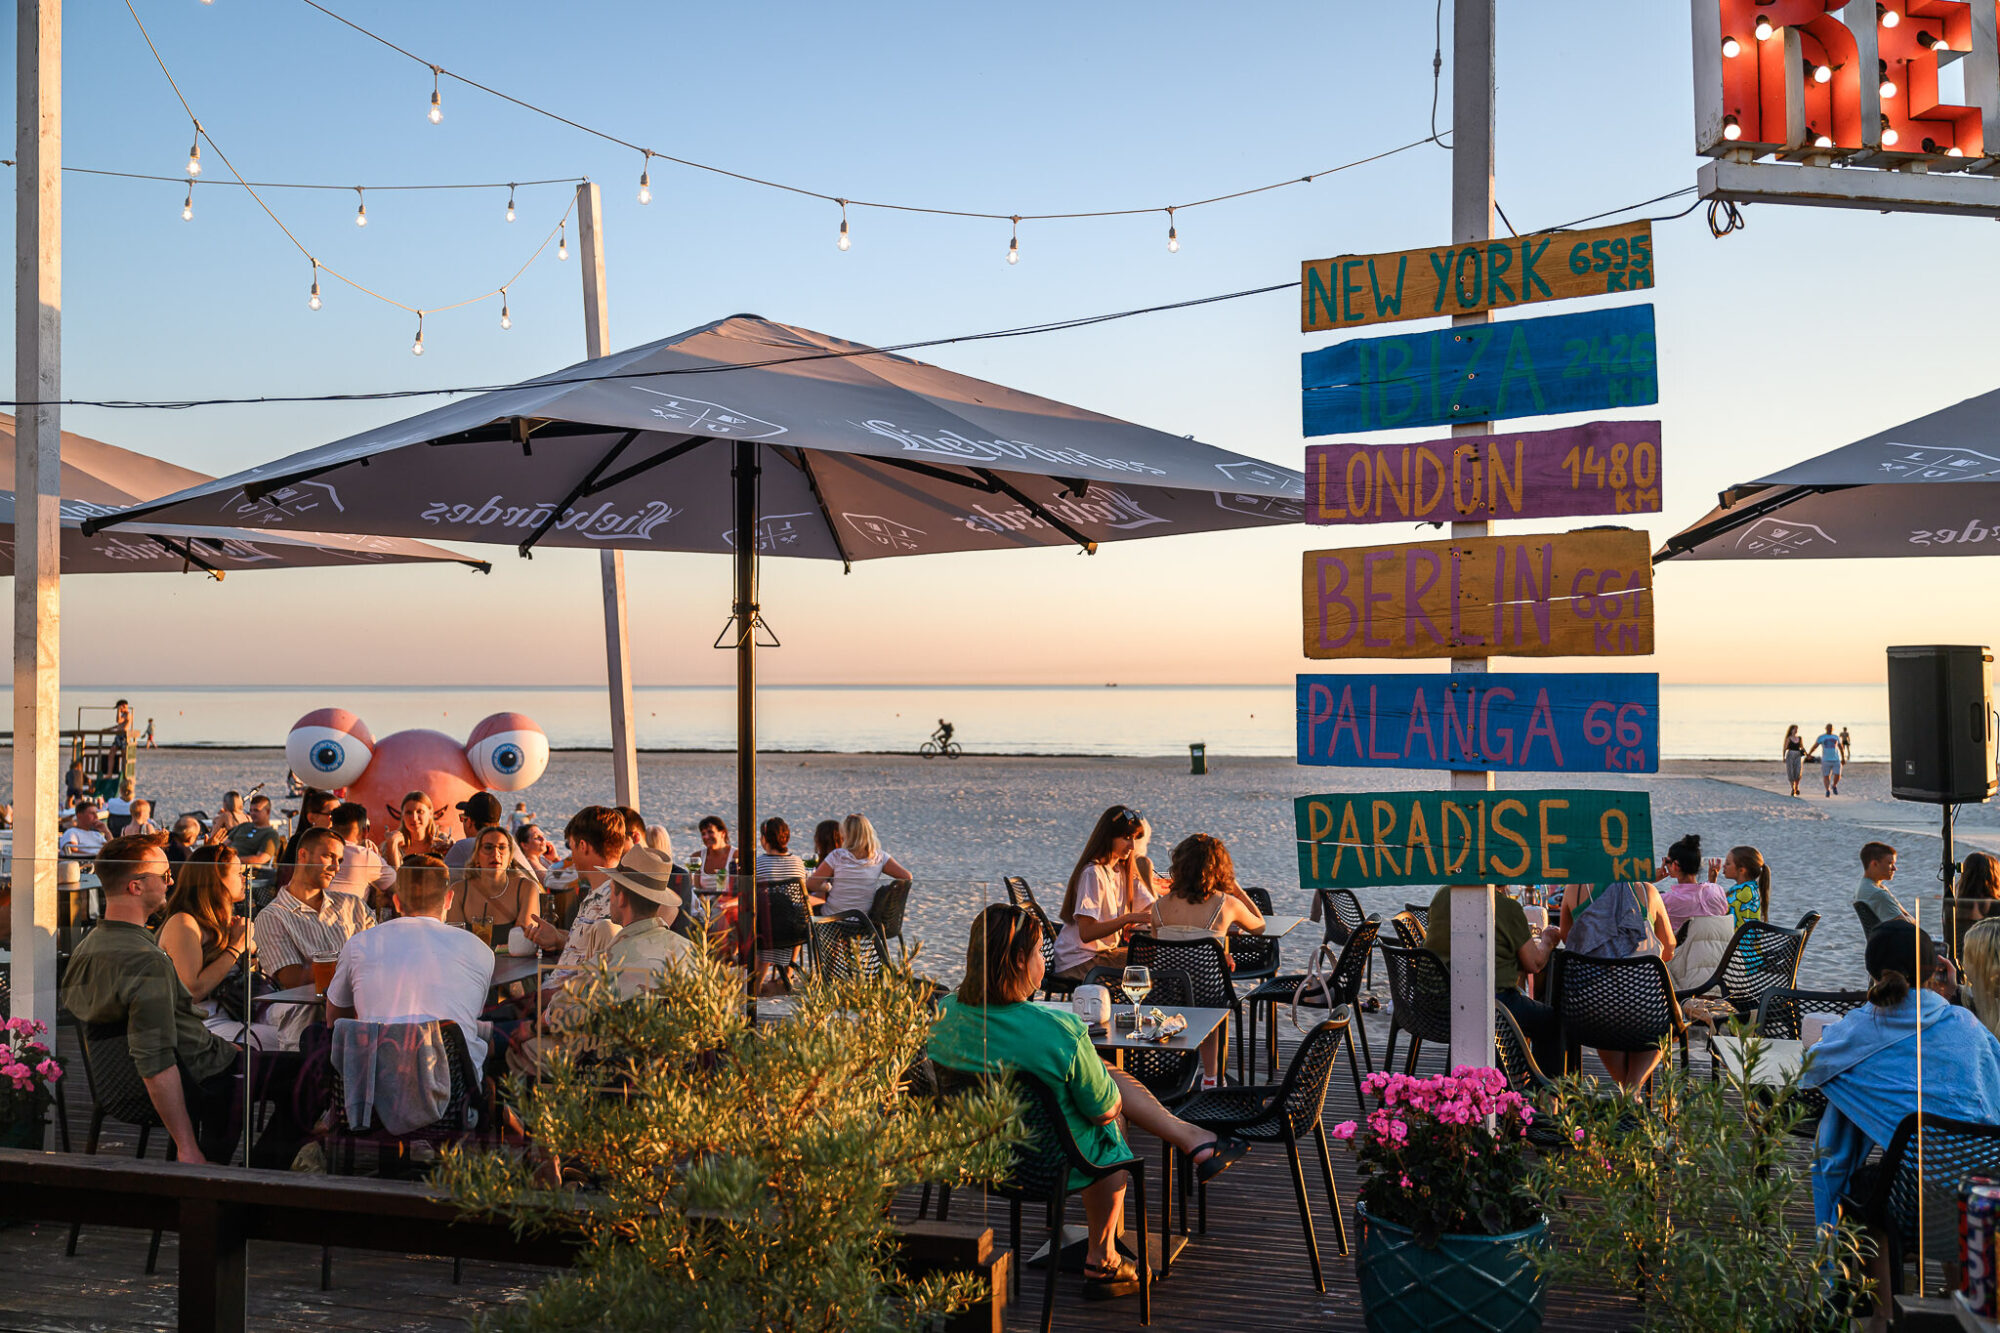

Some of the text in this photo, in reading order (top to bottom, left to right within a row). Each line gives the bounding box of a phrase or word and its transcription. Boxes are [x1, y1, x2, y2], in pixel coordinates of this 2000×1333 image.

[1692, 0, 2000, 163] RE
[1307, 234, 1651, 325] NEW YORK 6595
[1606, 268, 1651, 293] KM
[1358, 325, 1546, 428] IBIZA
[1608, 375, 1655, 406] KM
[1318, 440, 1657, 519] LONDON 1480
[1615, 488, 1659, 513] KM
[1315, 543, 1640, 649] BERLIN 661
[1594, 620, 1640, 653] KM
[1308, 683, 1648, 767] PALANGA 66
[1605, 746, 1645, 770] KM
[1308, 799, 1629, 880] PARADISE 0
[1612, 856, 1654, 881] KM
